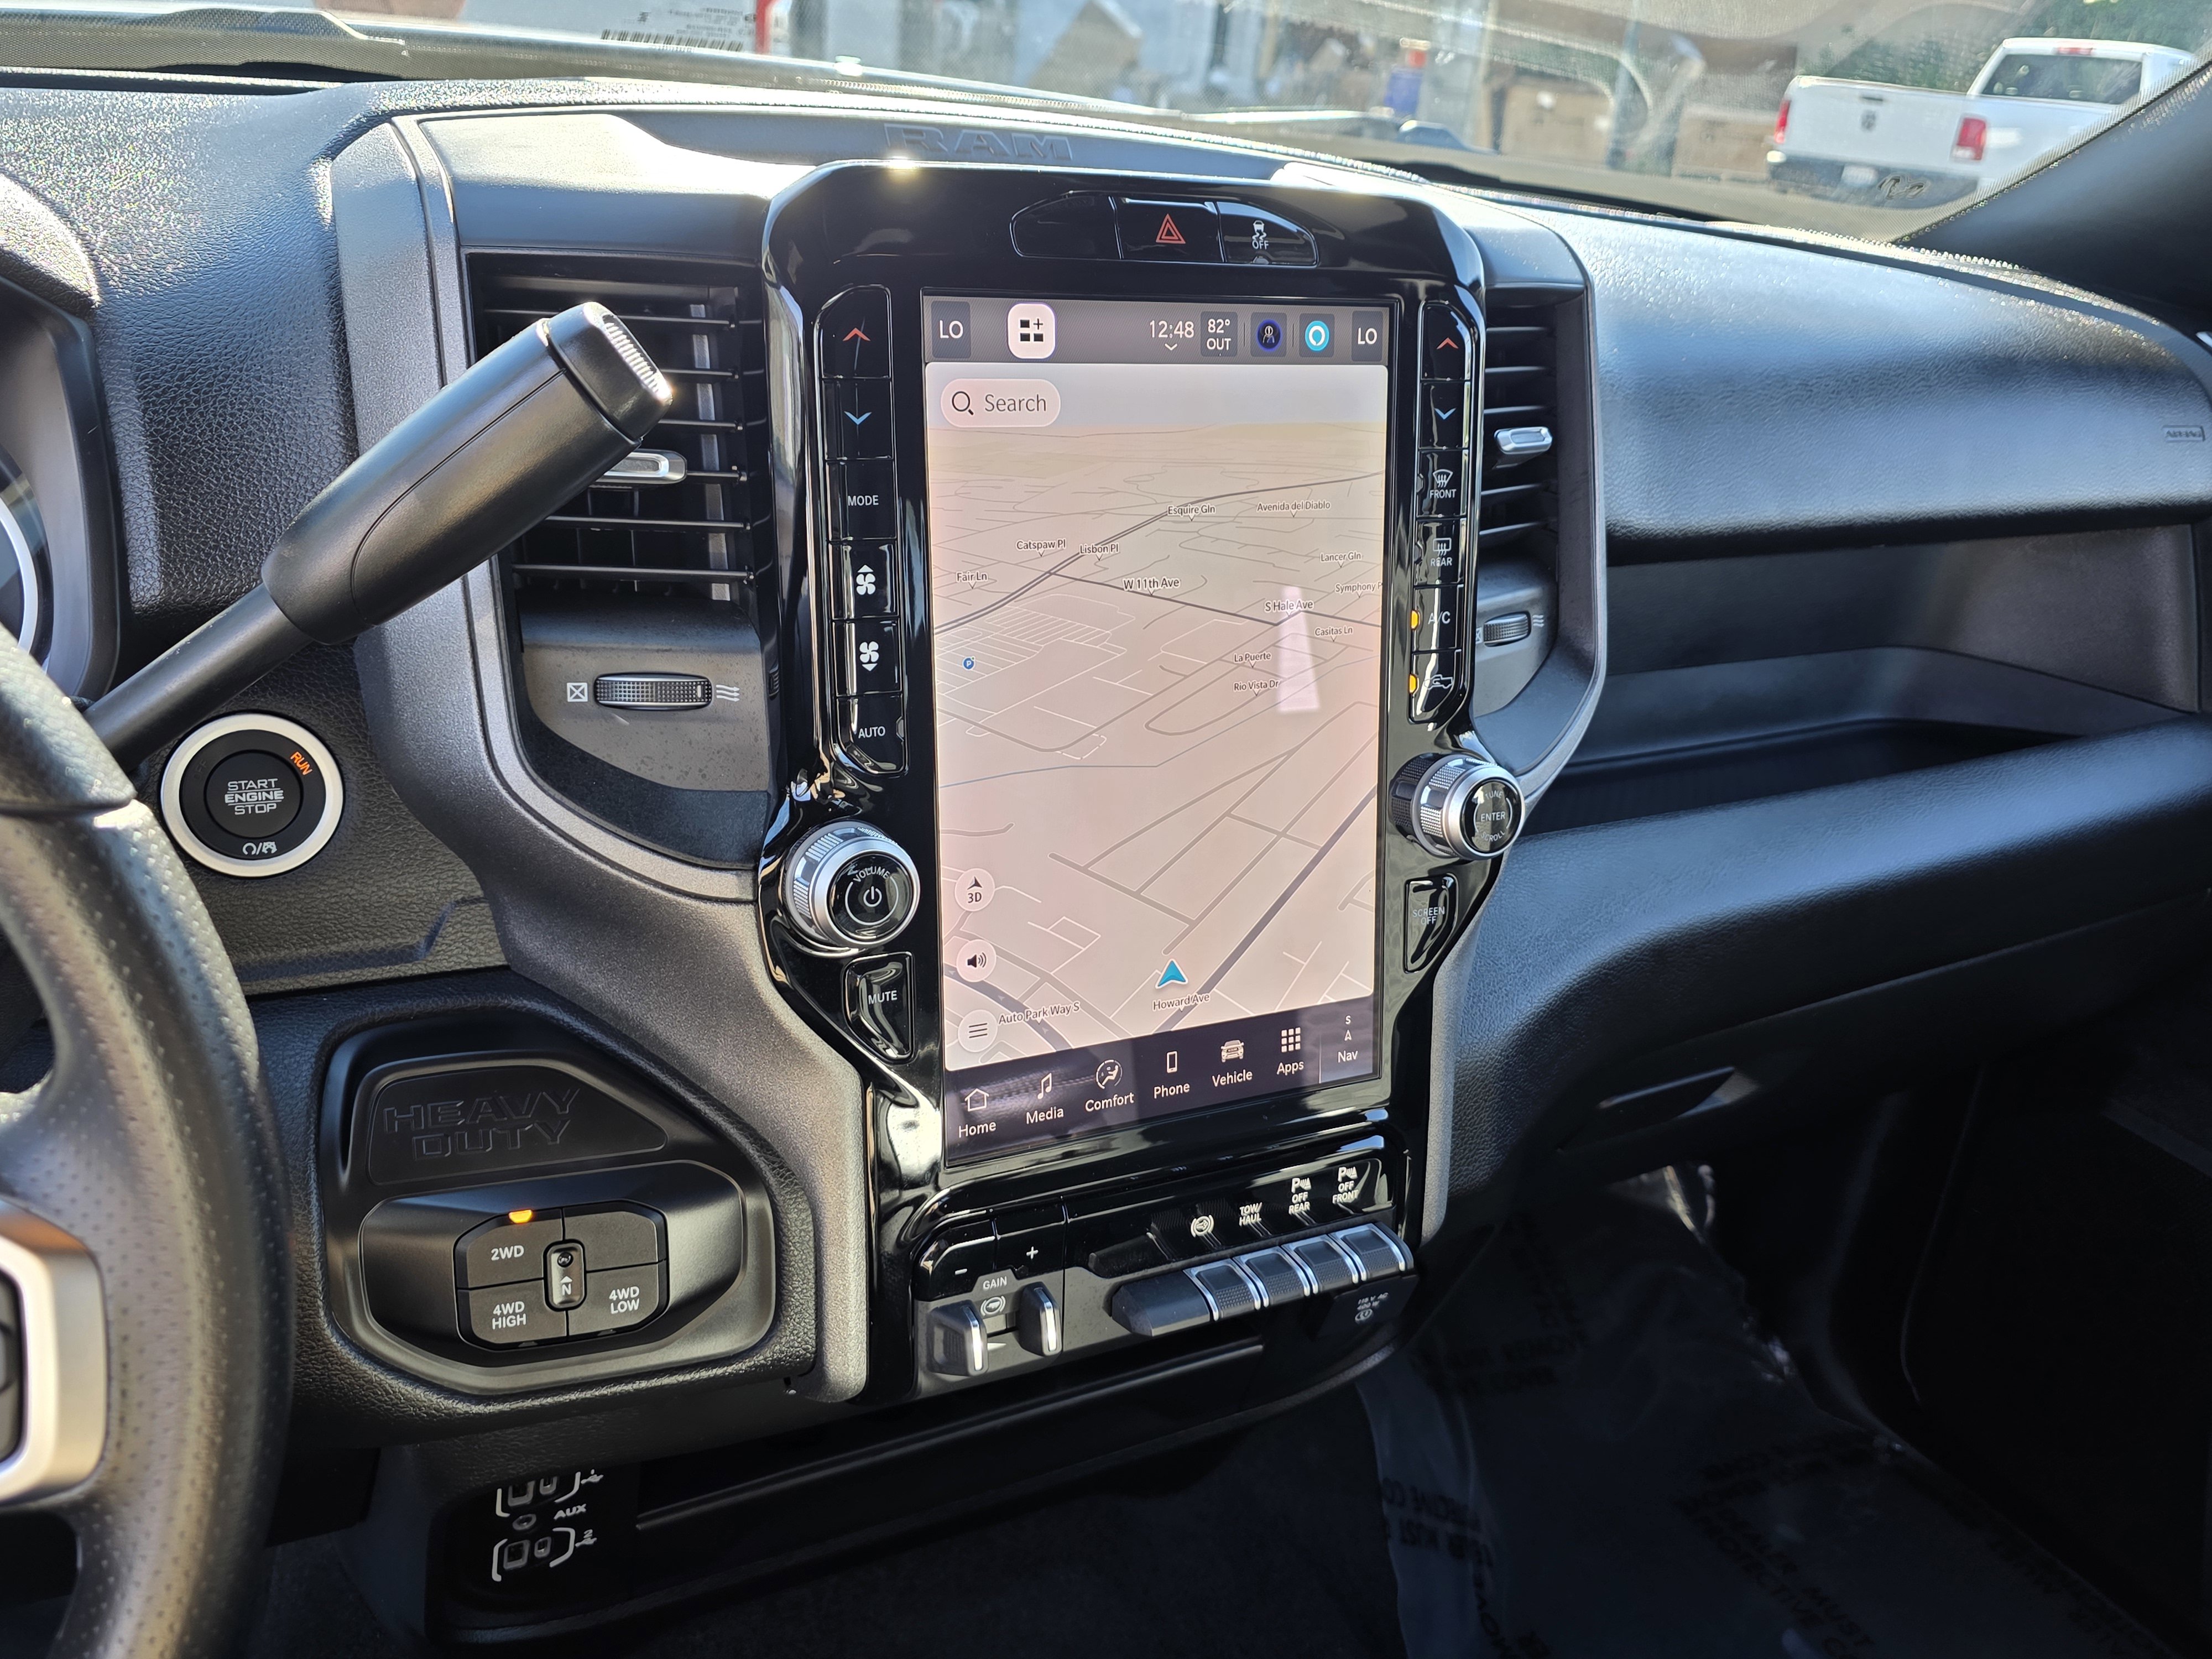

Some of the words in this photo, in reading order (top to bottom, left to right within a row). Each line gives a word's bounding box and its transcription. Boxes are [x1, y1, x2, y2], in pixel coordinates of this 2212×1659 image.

[884, 123, 1073, 160] RAM
[1251, 239, 1269, 250] OFF
[940, 320, 963, 340] LO
[1150, 320, 1194, 339] 12:48
[1358, 327, 1378, 345] LO
[1206, 338, 1232, 351] OUT
[984, 393, 1047, 413] Search
[1429, 489, 1457, 498] FRONT
[848, 495, 879, 507] MODE
[1257, 503, 1290, 512] Avenida
[1291, 502, 1303, 510] del
[1305, 501, 1331, 510] Diablo
[1168, 505, 1199, 515] Esquire
[1016, 540, 1056, 551] Catspaw
[1058, 539, 1066, 549] Pl
[1080, 544, 1108, 554] Lisbon
[1110, 543, 1119, 552] Pl
[1321, 553, 1346, 562] Lancer
[1430, 557, 1452, 567] REAR
[957, 572, 974, 581] Fair
[976, 572, 987, 581] Ln
[1123, 580, 1134, 589] W
[1136, 578, 1159, 589] 11th
[1161, 578, 1180, 588] Ave
[1335, 582, 1376, 593] Symphony
[1265, 602, 1271, 612] S
[1273, 601, 1294, 611] Hale
[1295, 601, 1313, 610] Ave
[1428, 611, 1451, 624] A/C
[1315, 627, 1342, 636] Casitas
[1343, 626, 1353, 635] Ln
[1234, 654, 1243, 662] La
[1245, 653, 1271, 661] Puerte
[1234, 682, 1246, 691] Rio
[1248, 681, 1267, 690] Vista
[1269, 680, 1279, 688] Dr
[858, 727, 886, 738] AUTO
[290, 751, 313, 776] RUN
[227, 778, 278, 792] START
[225, 790, 284, 804] ENGINE
[1485, 790, 1503, 800] TUNE
[234, 802, 277, 816] STOP
[1480, 811, 1506, 823] ENTER
[1480, 830, 1505, 842] SCROLL
[853, 865, 890, 883] VOLUME
[968, 892, 982, 904] 3D
[1412, 906, 1445, 918] SCREEN
[1421, 916, 1437, 925] OFF
[868, 990, 898, 1005] MUTE
[1153, 998, 1191, 1011] Howard
[1192, 993, 1210, 1005] Ave
[999, 1013, 1024, 1025] Auto
[1025, 1008, 1048, 1021] Park
[1050, 1004, 1072, 1018] Way
[1073, 1002, 1080, 1012] S
[1345, 1015, 1351, 1025] S
[1338, 1050, 1358, 1063] Nav
[1276, 1060, 1304, 1076] Apps
[1212, 1069, 1253, 1088] Vehicle
[1154, 1081, 1190, 1099] Phone
[1085, 1092, 1135, 1113] Comfort
[383, 1088, 580, 1135] HEAVY
[1026, 1106, 1064, 1124] Media
[958, 1120, 997, 1138] Home
[411, 1119, 571, 1162] DUTY
[1338, 1181, 1354, 1193] OFF
[1292, 1192, 1308, 1204] OFF
[1333, 1190, 1359, 1204] FRONT
[1240, 1202, 1262, 1215] TOW/
[1288, 1201, 1310, 1214] REAR
[1239, 1213, 1262, 1227] HAUL
[491, 1244, 524, 1261] 2WD
[562, 1282, 572, 1296] N
[982, 1275, 1008, 1291] GAIN
[608, 1285, 640, 1301] 4WD
[493, 1300, 525, 1318] 4WD
[610, 1297, 640, 1314] LOW
[492, 1312, 526, 1329] HIGH
[554, 1503, 587, 1520] AUX
